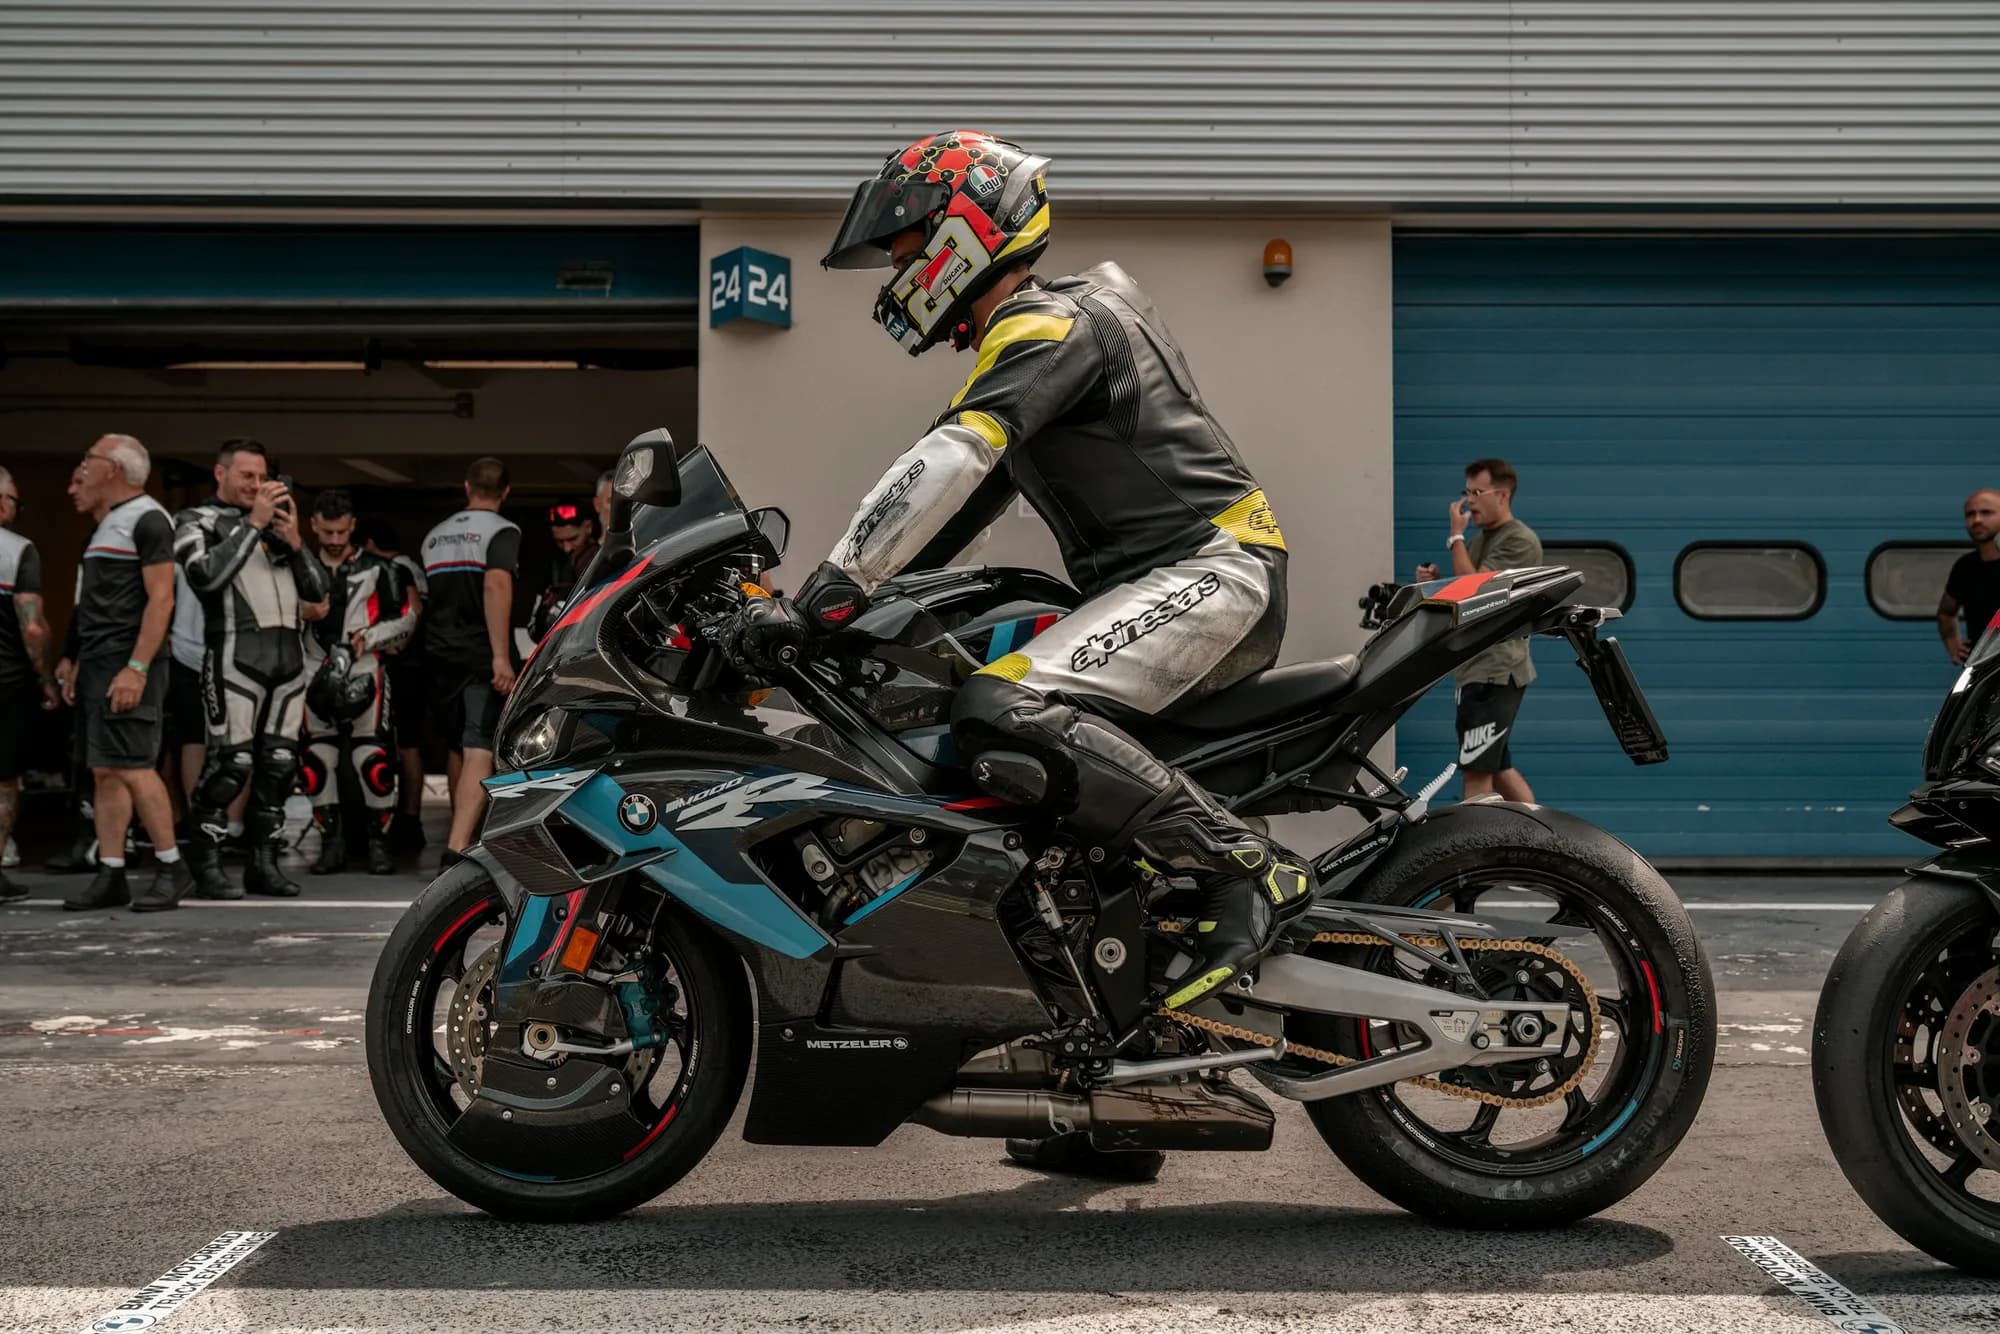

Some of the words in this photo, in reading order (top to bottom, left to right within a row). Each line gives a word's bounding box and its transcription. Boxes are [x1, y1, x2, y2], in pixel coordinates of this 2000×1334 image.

[980, 177, 1000, 194] agv
[1011, 195, 1035, 222] GoPro
[712, 264, 741, 310] 24
[748, 264, 788, 311] 24
[943, 262, 964, 285] DUCATI
[843, 459, 925, 568] alpinestars
[1071, 572, 1220, 672] alpinestars
[1464, 721, 1496, 750] NIKE
[1320, 840, 1378, 873] METZELER
[806, 1040, 892, 1049] METZELER
[1405, 1122, 1436, 1148] MOTORRAD
[116, 1285, 169, 1310] BMW
[159, 1232, 244, 1282] MOTORRAD
[150, 1281, 203, 1311] TRACK
[193, 1231, 272, 1280] EXPERIENCE
[1724, 1236, 1809, 1287] MOTORRAD
[1751, 1236, 1832, 1285] EXPERIENCE
[1794, 1290, 1849, 1316] BMW
[1820, 1286, 1876, 1316] TRACK
